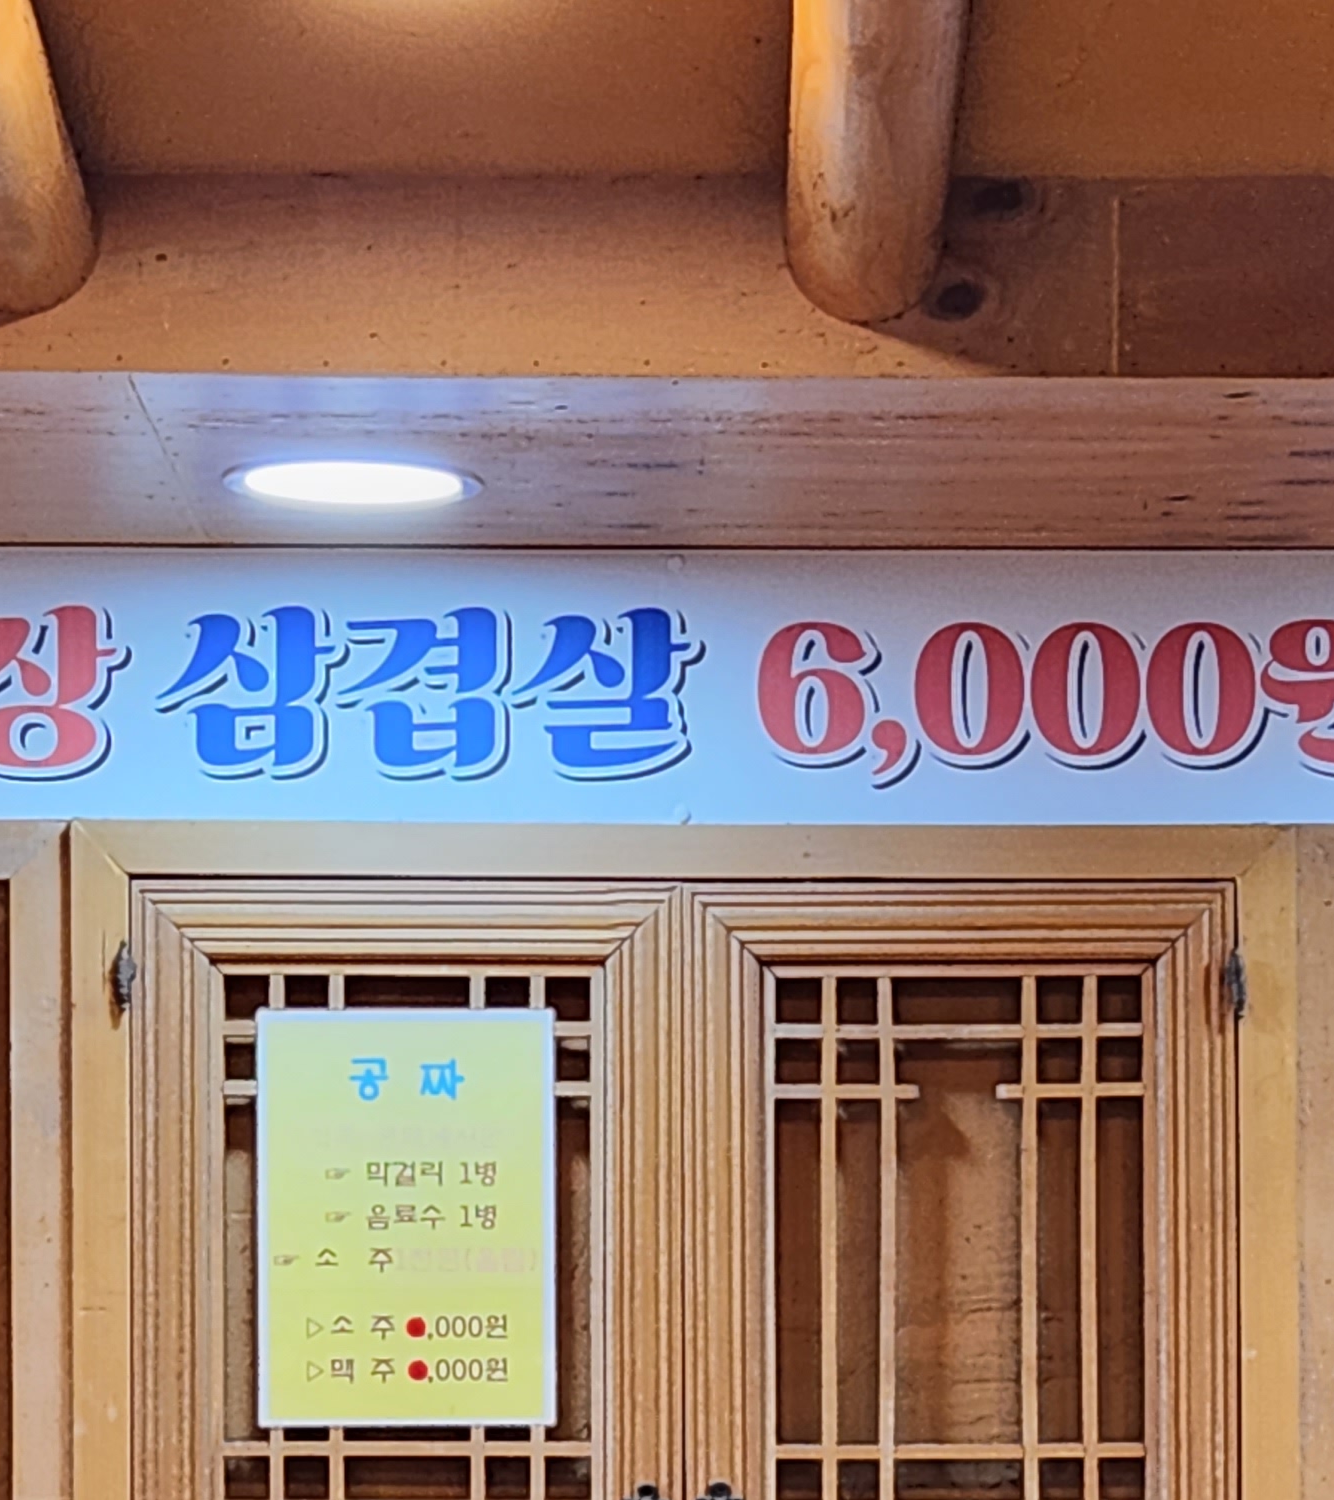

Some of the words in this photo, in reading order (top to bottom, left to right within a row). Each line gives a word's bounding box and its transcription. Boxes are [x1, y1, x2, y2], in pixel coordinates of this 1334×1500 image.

[155, 604, 706, 782] 삼겹살
[366, 1161, 443, 1187] 막걸리
[460, 1161, 497, 1187] 1병
[367, 1204, 445, 1231] 음료수
[460, 1204, 497, 1230] 1병
[405, 1314, 509, 1341] ,000원
[407, 1358, 509, 1384] ,000원
